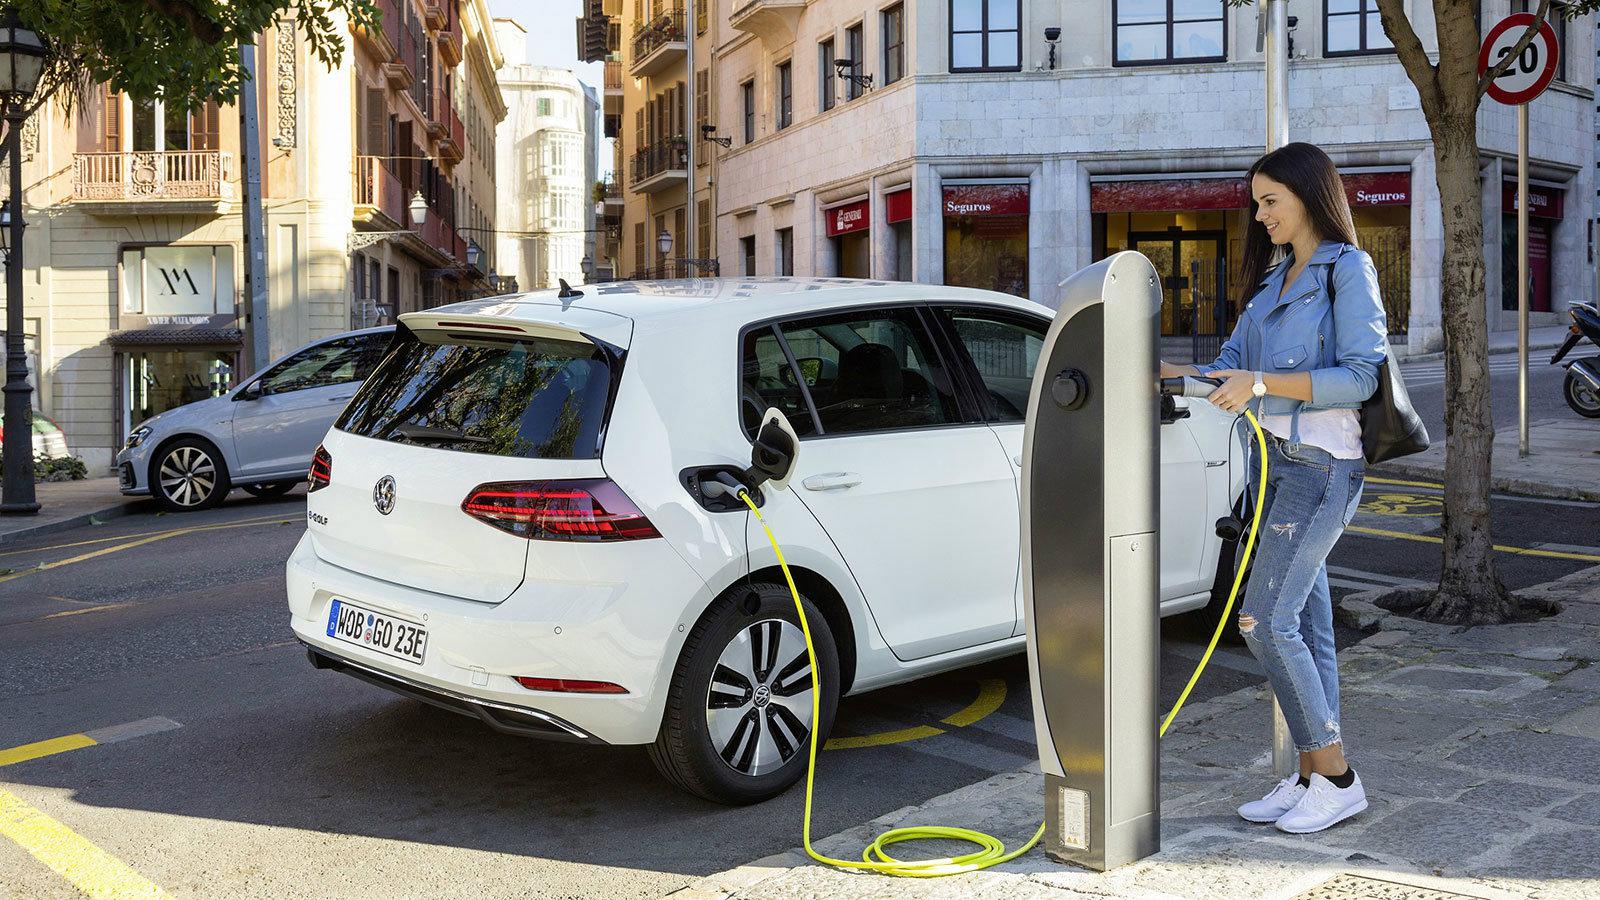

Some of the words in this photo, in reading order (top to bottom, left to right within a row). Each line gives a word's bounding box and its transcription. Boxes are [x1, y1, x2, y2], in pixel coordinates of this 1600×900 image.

[1497, 42, 1538, 78] 20
[947, 201, 991, 214] Seguros
[1357, 190, 1406, 205] Seguros
[337, 607, 365, 639] WOB
[372, 618, 393, 648] GO
[394, 624, 426, 659] 23E
